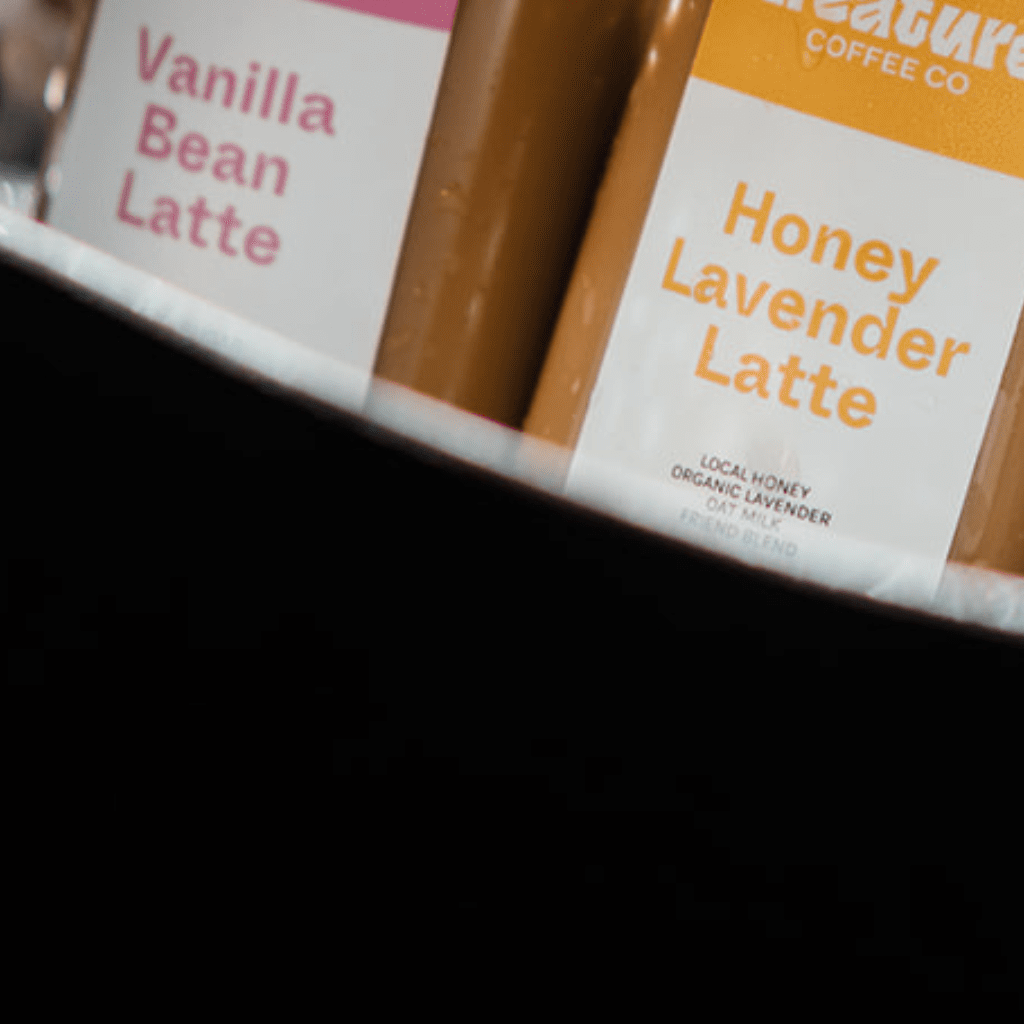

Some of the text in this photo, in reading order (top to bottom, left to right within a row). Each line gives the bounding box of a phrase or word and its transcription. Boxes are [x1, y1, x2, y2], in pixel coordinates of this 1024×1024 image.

[137, 26, 335, 136] Vanilla
[805, 28, 970, 95] COFFEE CO
[137, 104, 288, 196] Bean
[116, 171, 281, 265] Latte
[722, 181, 940, 305] Honey
[661, 237, 971, 377] Lavender
[694, 325, 877, 429] Latte
[671, 464, 832, 526] ORGANIC LAVENDER
[700, 454, 811, 499] LOCAL HONEY
[706, 497, 782, 532] OAT MILK
